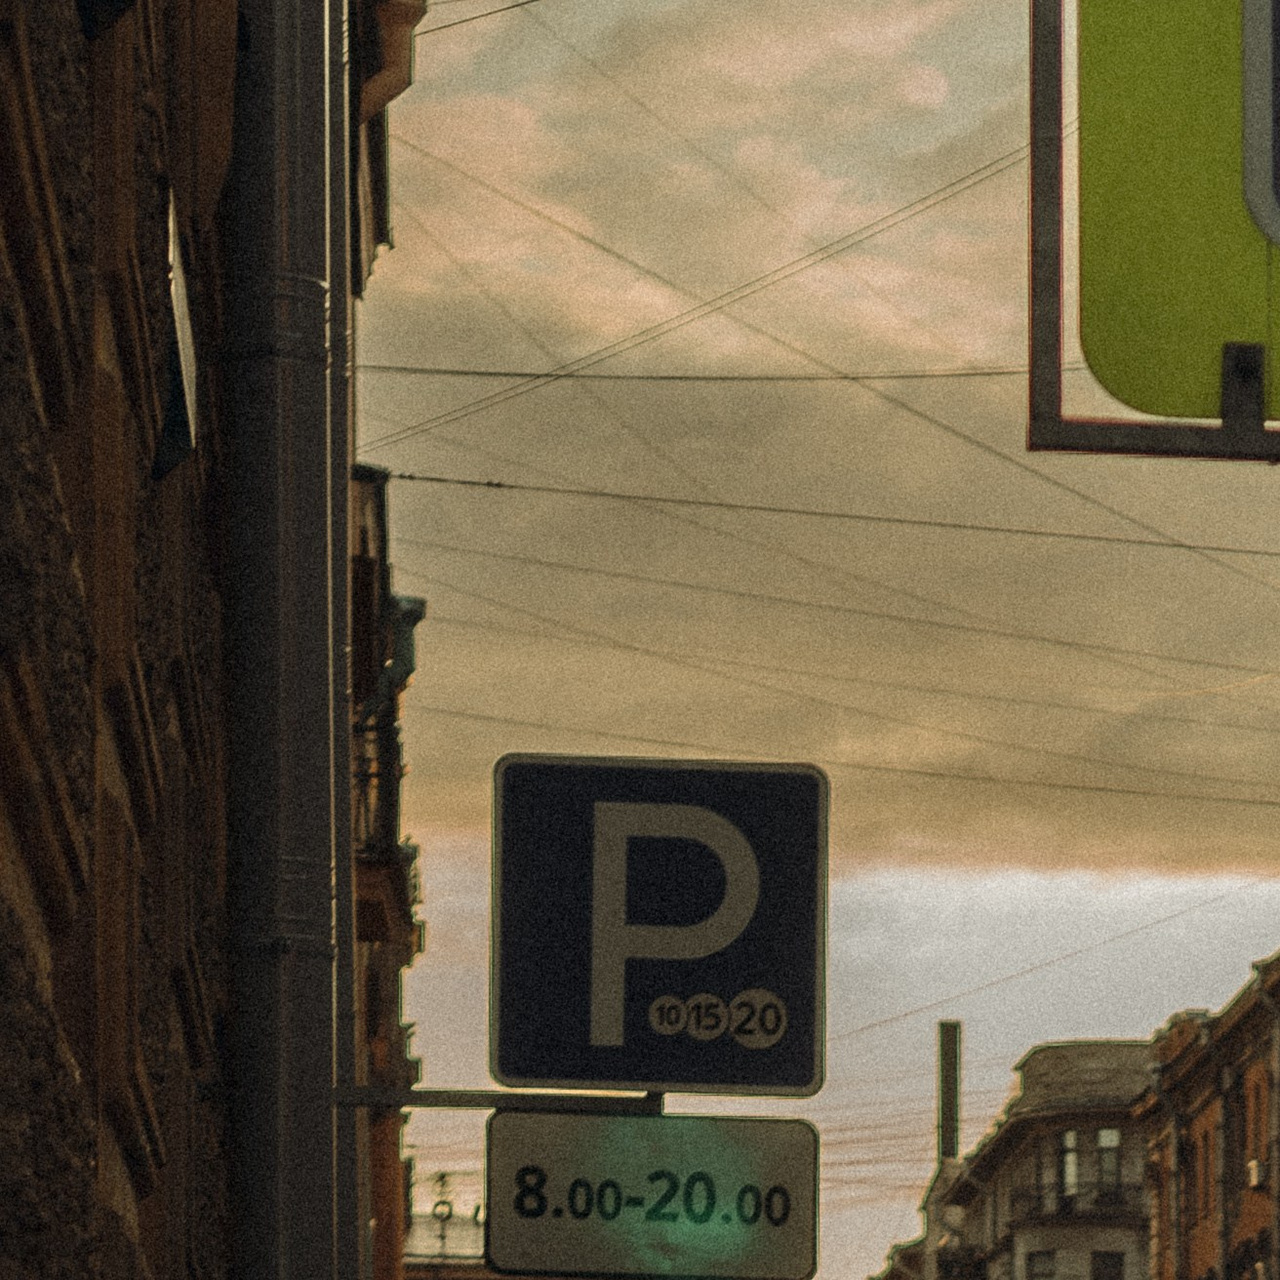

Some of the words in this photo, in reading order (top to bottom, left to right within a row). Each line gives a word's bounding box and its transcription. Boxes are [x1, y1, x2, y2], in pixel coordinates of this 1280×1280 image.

[590, 803, 761, 1047] P
[656, 1004, 682, 1026] 10
[691, 1002, 722, 1031] 15
[735, 1001, 782, 1036] 20
[514, 1165, 791, 1227] 8.00-20.00
